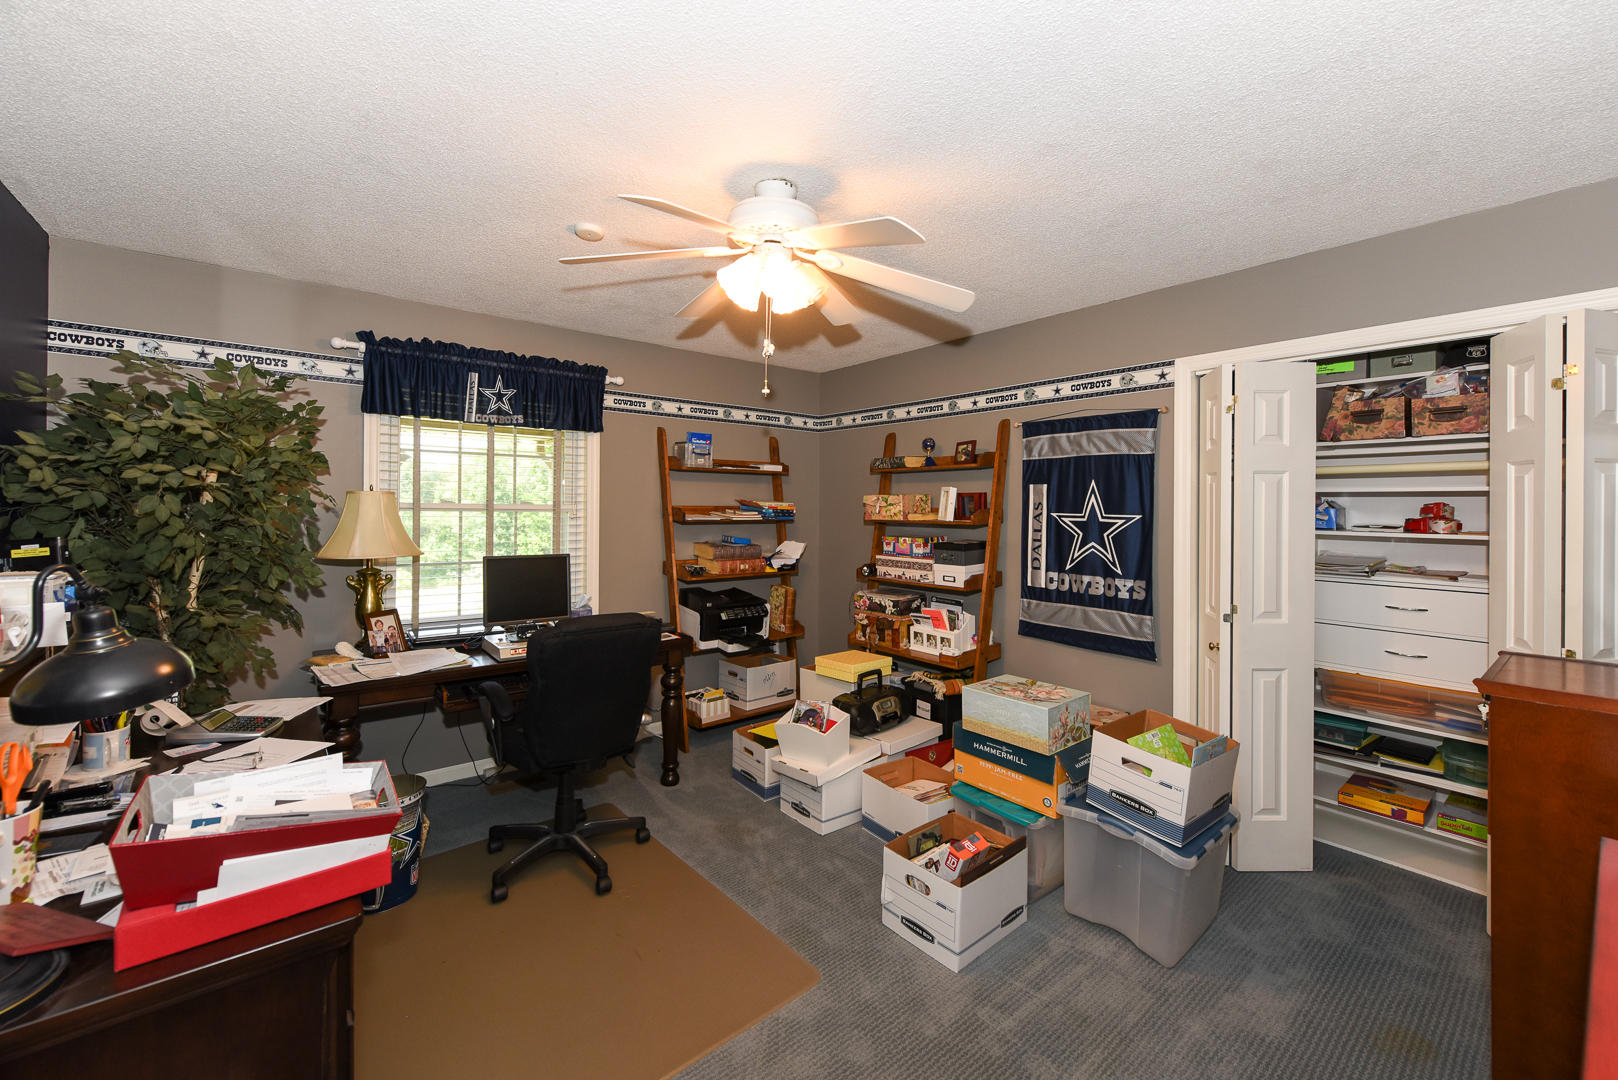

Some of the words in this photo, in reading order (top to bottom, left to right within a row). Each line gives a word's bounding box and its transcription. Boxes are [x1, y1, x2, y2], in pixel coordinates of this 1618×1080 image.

[47, 331, 125, 349] COWBOYS
[226, 352, 288, 368] COWBOYS
[1070, 379, 1112, 392] COWBOYS
[468, 380, 476, 414] DALLAS
[613, 398, 647, 408] COWBOYS
[985, 393, 1018, 405] COWBOYS
[689, 407, 719, 416] COWBOYS
[917, 400, 944, 410] COWBOYS
[475, 413, 524, 424] COWBOYS
[755, 414, 780, 423] COWBOYS
[861, 413, 883, 422] COWBOYS
[1031, 501, 1044, 571] DALLAS
[1046, 571, 1146, 600] COWBOYS
[973, 742, 1027, 766] HAMMERMILL
[1111, 792, 1140, 809] BANKERS
[1140, 804, 1154, 816] BOX
